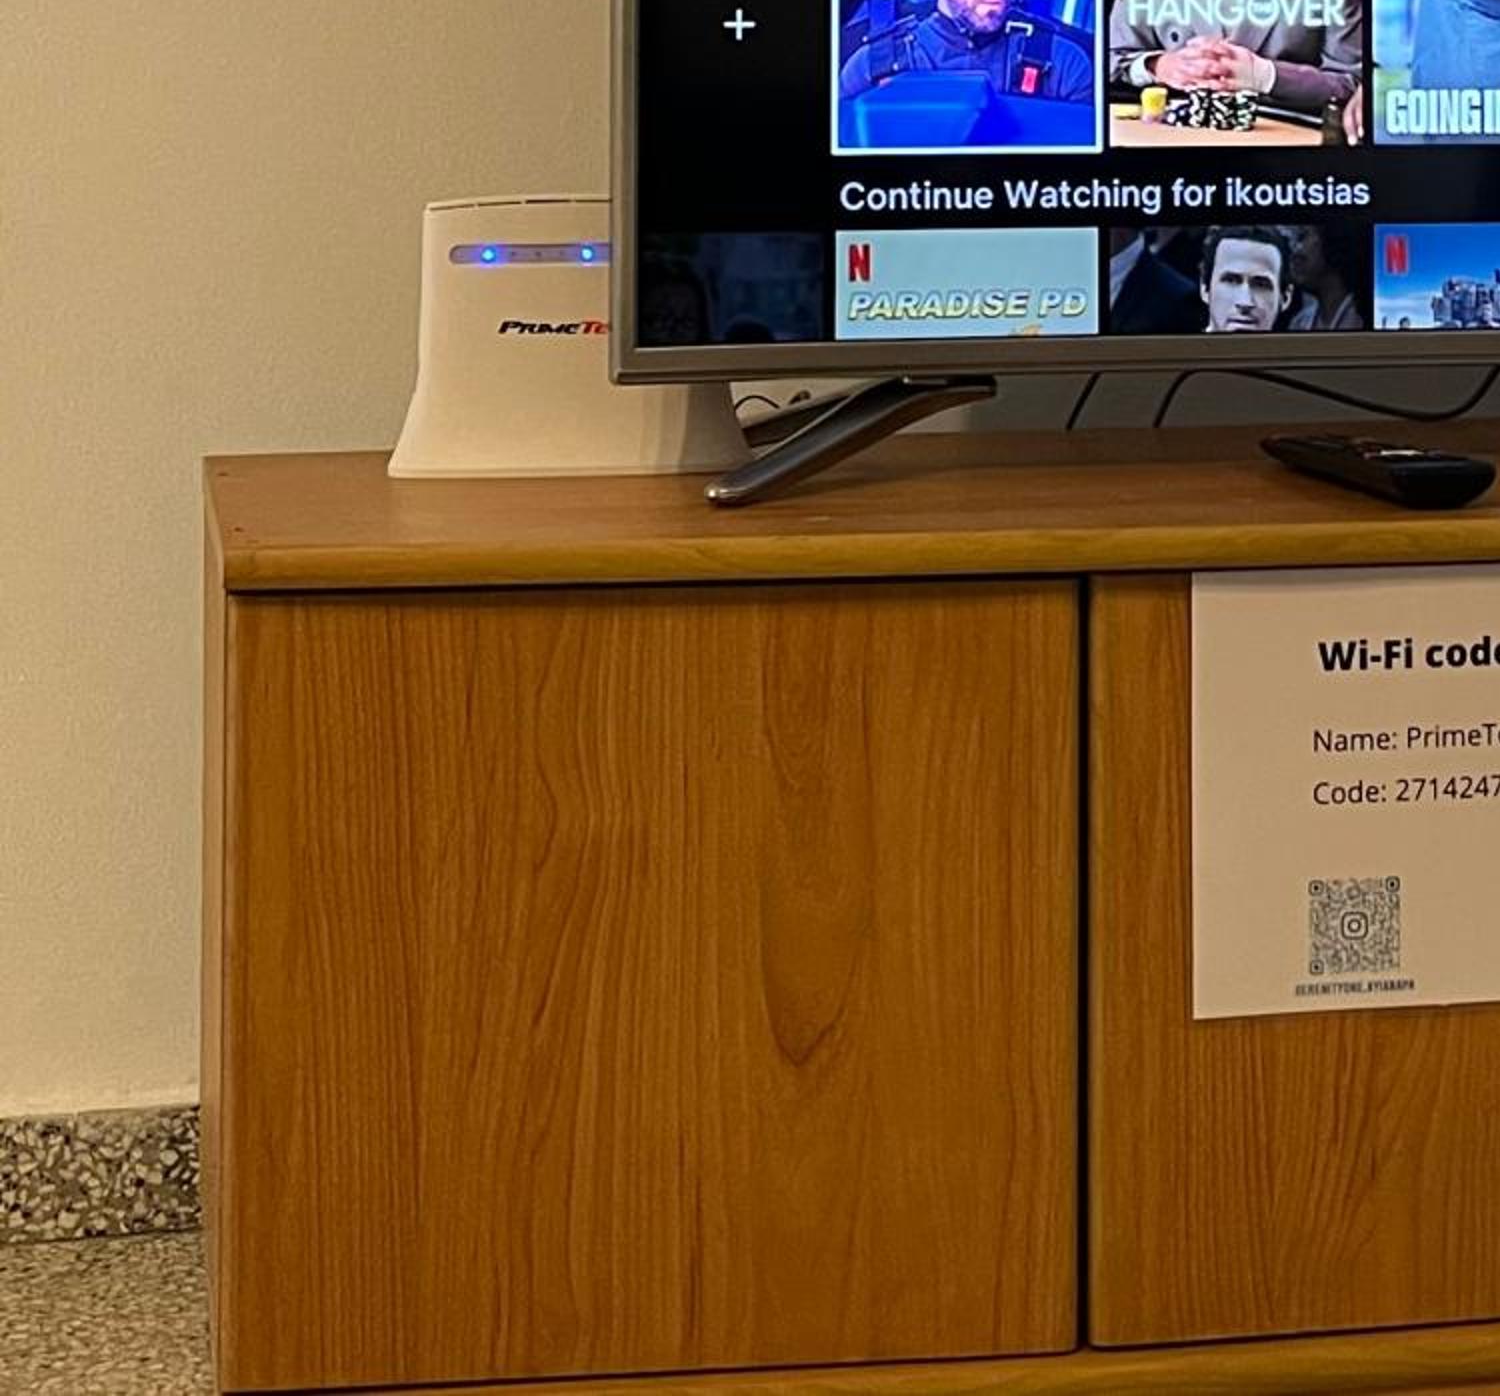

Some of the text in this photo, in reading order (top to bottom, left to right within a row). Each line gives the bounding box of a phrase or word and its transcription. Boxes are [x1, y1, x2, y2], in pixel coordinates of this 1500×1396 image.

[840, 176, 1370, 214] Continue Watching for ikoutsias
[848, 288, 1087, 320] PARADISE PD
[1319, 638, 1413, 672] Wi-Fi
[1313, 727, 1397, 753] Name:
[1313, 781, 1387, 805] Code:
